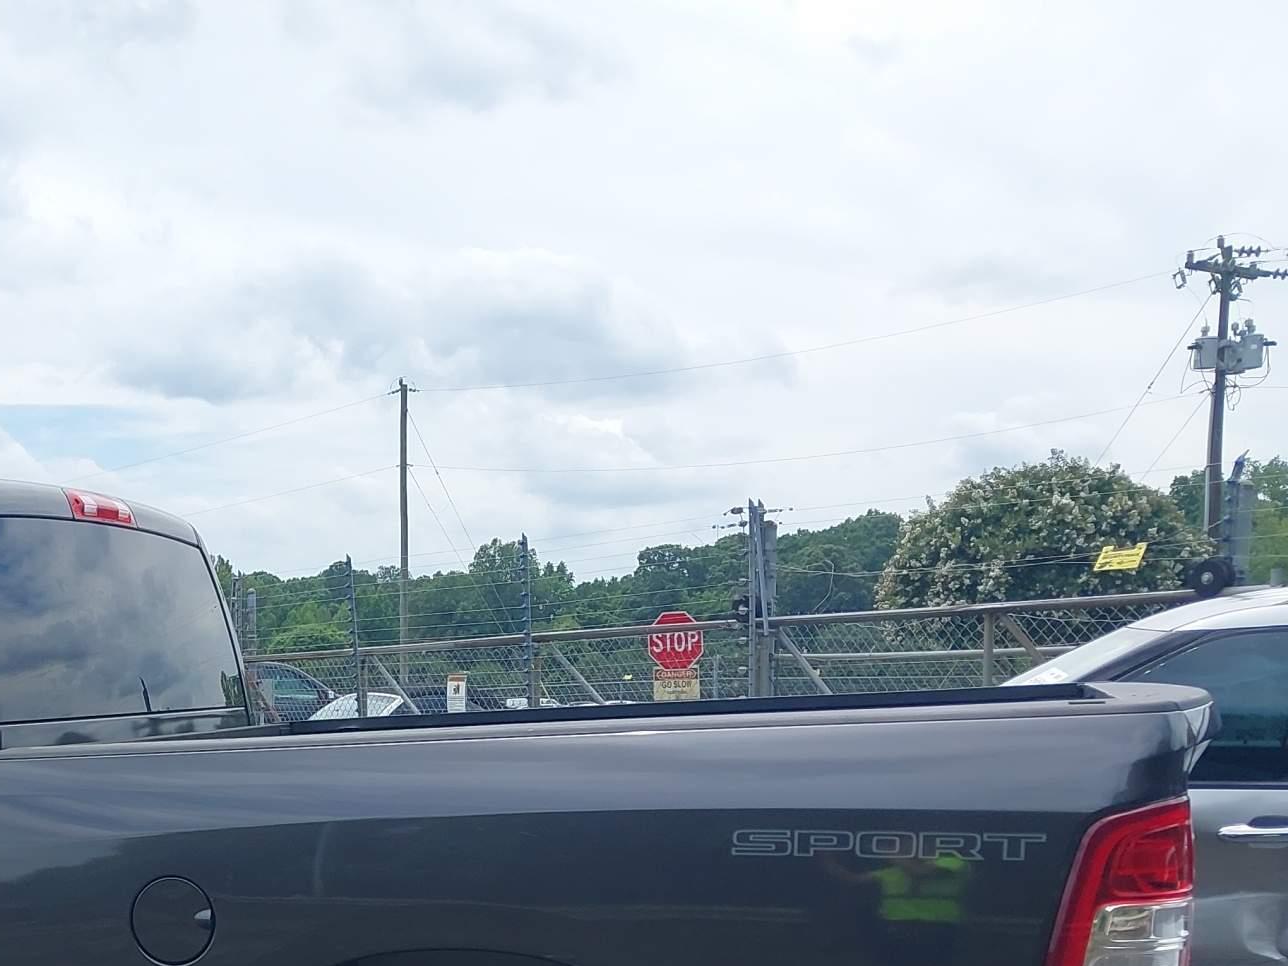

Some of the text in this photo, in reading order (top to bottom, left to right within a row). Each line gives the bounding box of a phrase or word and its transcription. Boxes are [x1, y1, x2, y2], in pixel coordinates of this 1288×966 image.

[653, 632, 699, 653] STOP
[662, 680, 692, 689] GO SLOW
[731, 829, 1047, 861] SPORT
